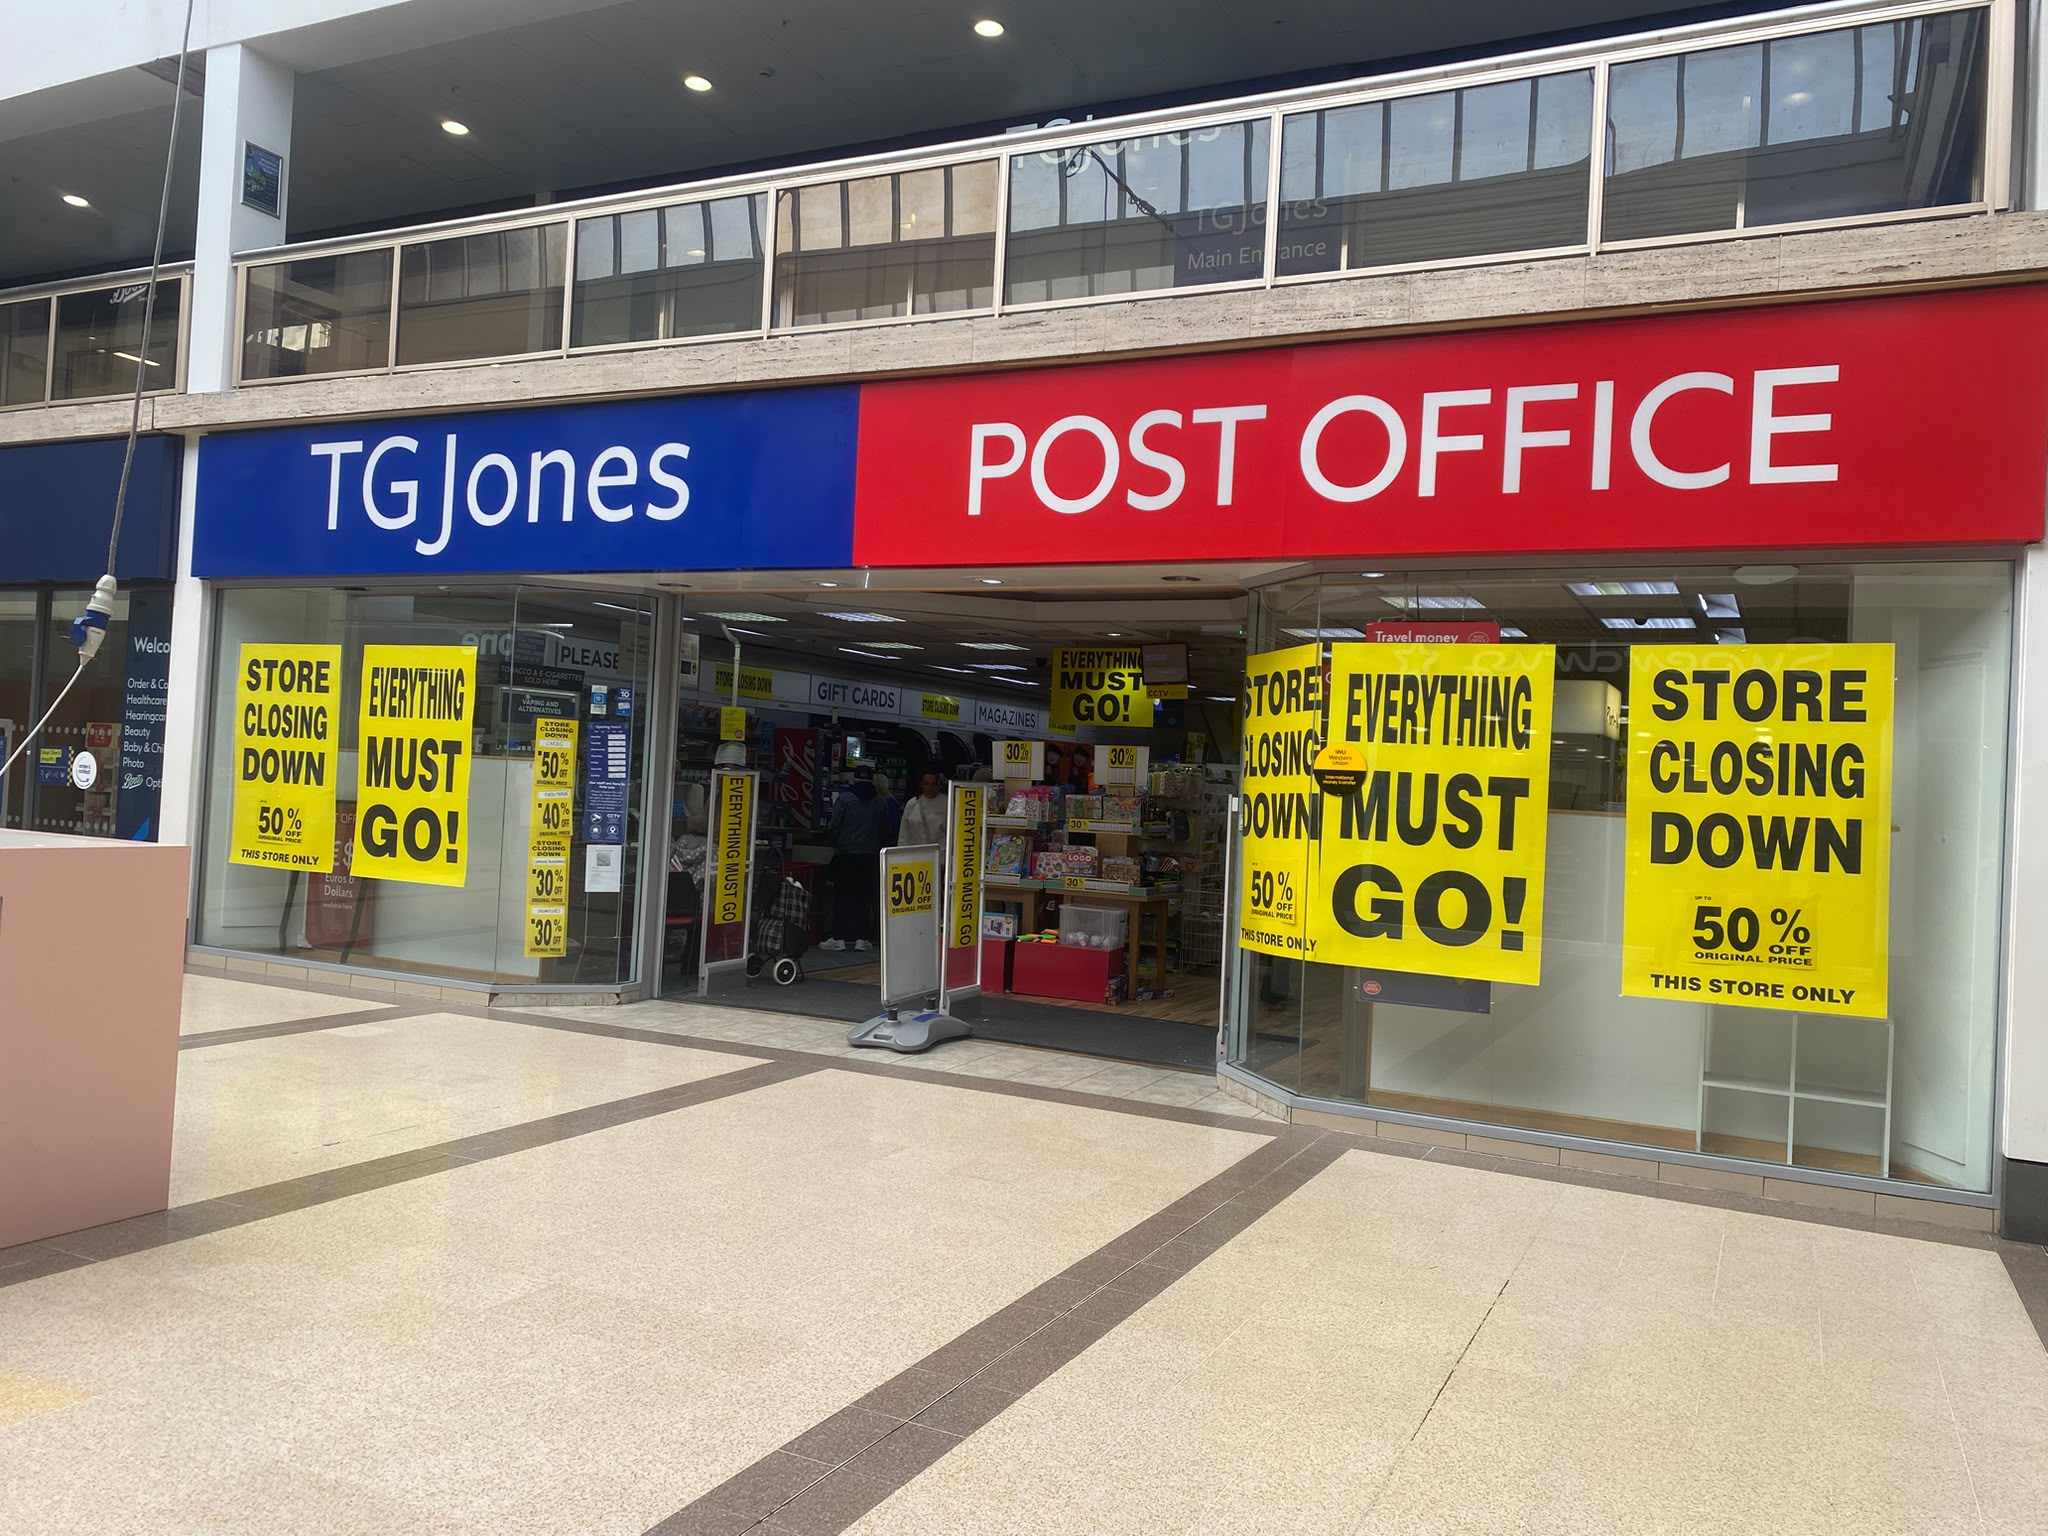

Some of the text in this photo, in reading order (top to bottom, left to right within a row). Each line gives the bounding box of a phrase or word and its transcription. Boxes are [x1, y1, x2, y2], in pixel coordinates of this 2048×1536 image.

[1188, 241, 1327, 270] Main Enance
[967, 364, 1840, 516] POST OFFICE
[310, 434, 691, 556] TGJones
[1375, 630, 1412, 643] Travel
[1415, 633, 1459, 643] money
[561, 646, 619, 669] PLEASE
[127, 678, 150, 689] Order
[151, 679, 157, 689] &
[246, 659, 330, 693] STORE
[524, 676, 559, 687] SOLD HERE
[738, 673, 756, 691] LOSING
[1060, 672, 1144, 690] MUST
[127, 694, 167, 706] Healthcare
[369, 666, 465, 721] EVERYTHING
[522, 698, 545, 707] VAPING
[818, 681, 895, 709] GIFT CARDS
[1148, 689, 1168, 697] CCTV
[1244, 666, 1322, 718] STORE
[1651, 669, 1867, 722] STORE
[518, 705, 562, 715] ALTERNATIVES
[980, 706, 1036, 728] MAGAZINES
[1072, 694, 1130, 722] GO!
[1345, 673, 1532, 751] EVERYTHING
[125, 725, 151, 739] Beauty
[244, 703, 327, 740] CLOSING
[123, 741, 143, 755] Baby
[144, 743, 150, 752] &
[122, 757, 145, 769] Photo
[242, 747, 325, 786] DOWN
[366, 736, 463, 793] MUST
[1649, 739, 1865, 799] CLOSING
[726, 777, 744, 859] EVERYTHING
[1242, 792, 1319, 840] DOWN
[1339, 770, 1529, 852] MUST
[361, 804, 460, 863] GO!
[961, 789, 976, 878] EVERYTHING
[1650, 812, 1862, 874] DOWN
[241, 848, 319, 866] THIS STORE ONLY
[324, 885, 353, 898] Dollars
[725, 863, 739, 898] MUST
[722, 904, 736, 922] GO
[891, 906, 916, 914] ORIGINAL
[917, 897, 932, 905] OFF
[961, 882, 973, 921] MUST
[1276, 902, 1294, 912] OFF
[1332, 863, 1527, 952] GO!
[1251, 908, 1294, 921] ORIGINAL PRICE
[960, 924, 972, 946] GO
[1241, 927, 1317, 953] THIS STORE ONLY
[1694, 951, 1812, 966] ORIGINAL PRICE
[1768, 944, 1812, 956] OFF
[1651, 973, 1856, 1004] THIS STORE ONLY
